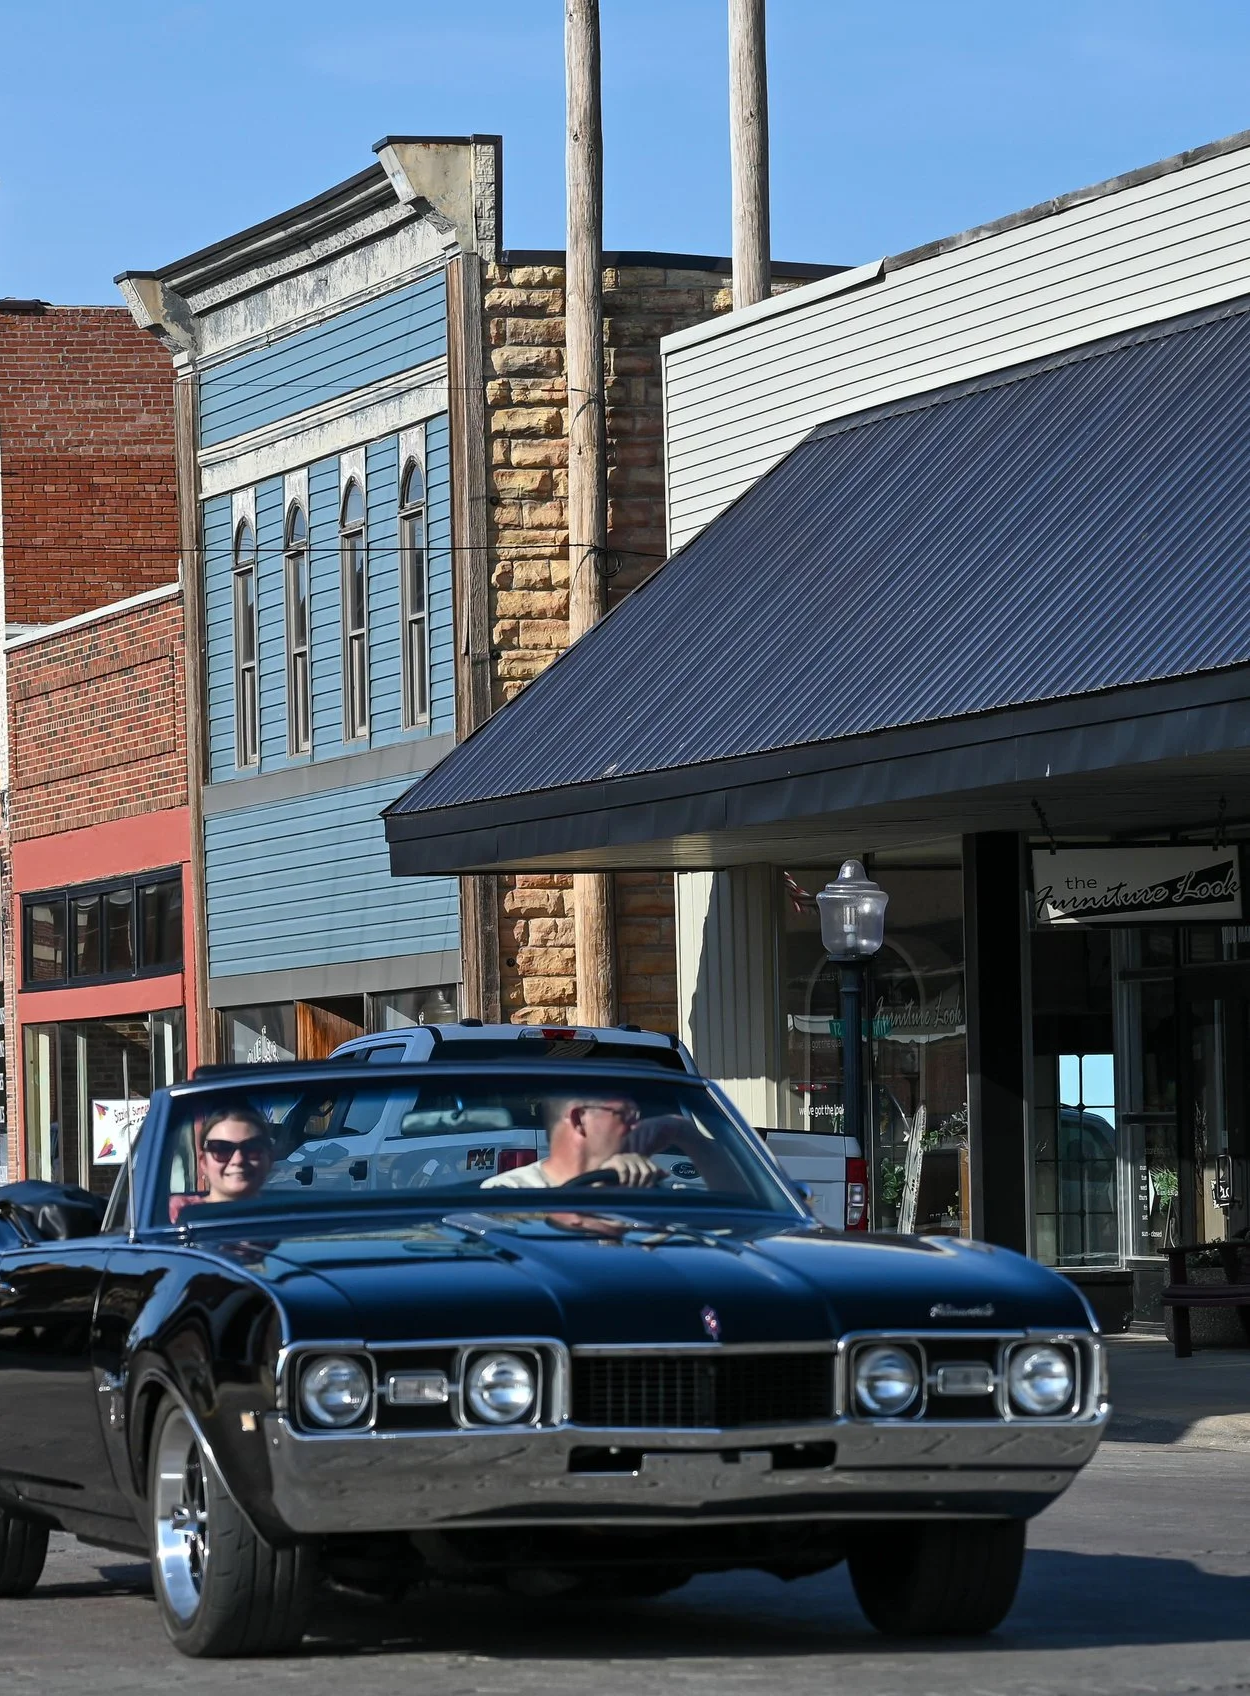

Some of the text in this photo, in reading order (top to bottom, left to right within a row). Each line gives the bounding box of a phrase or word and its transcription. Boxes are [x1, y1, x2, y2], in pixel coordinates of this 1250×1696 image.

[1035, 870, 1242, 919] Furniture Look
[1065, 877, 1097, 890] the
[933, 993, 962, 1027] Look
[466, 1147, 496, 1170] FX4
